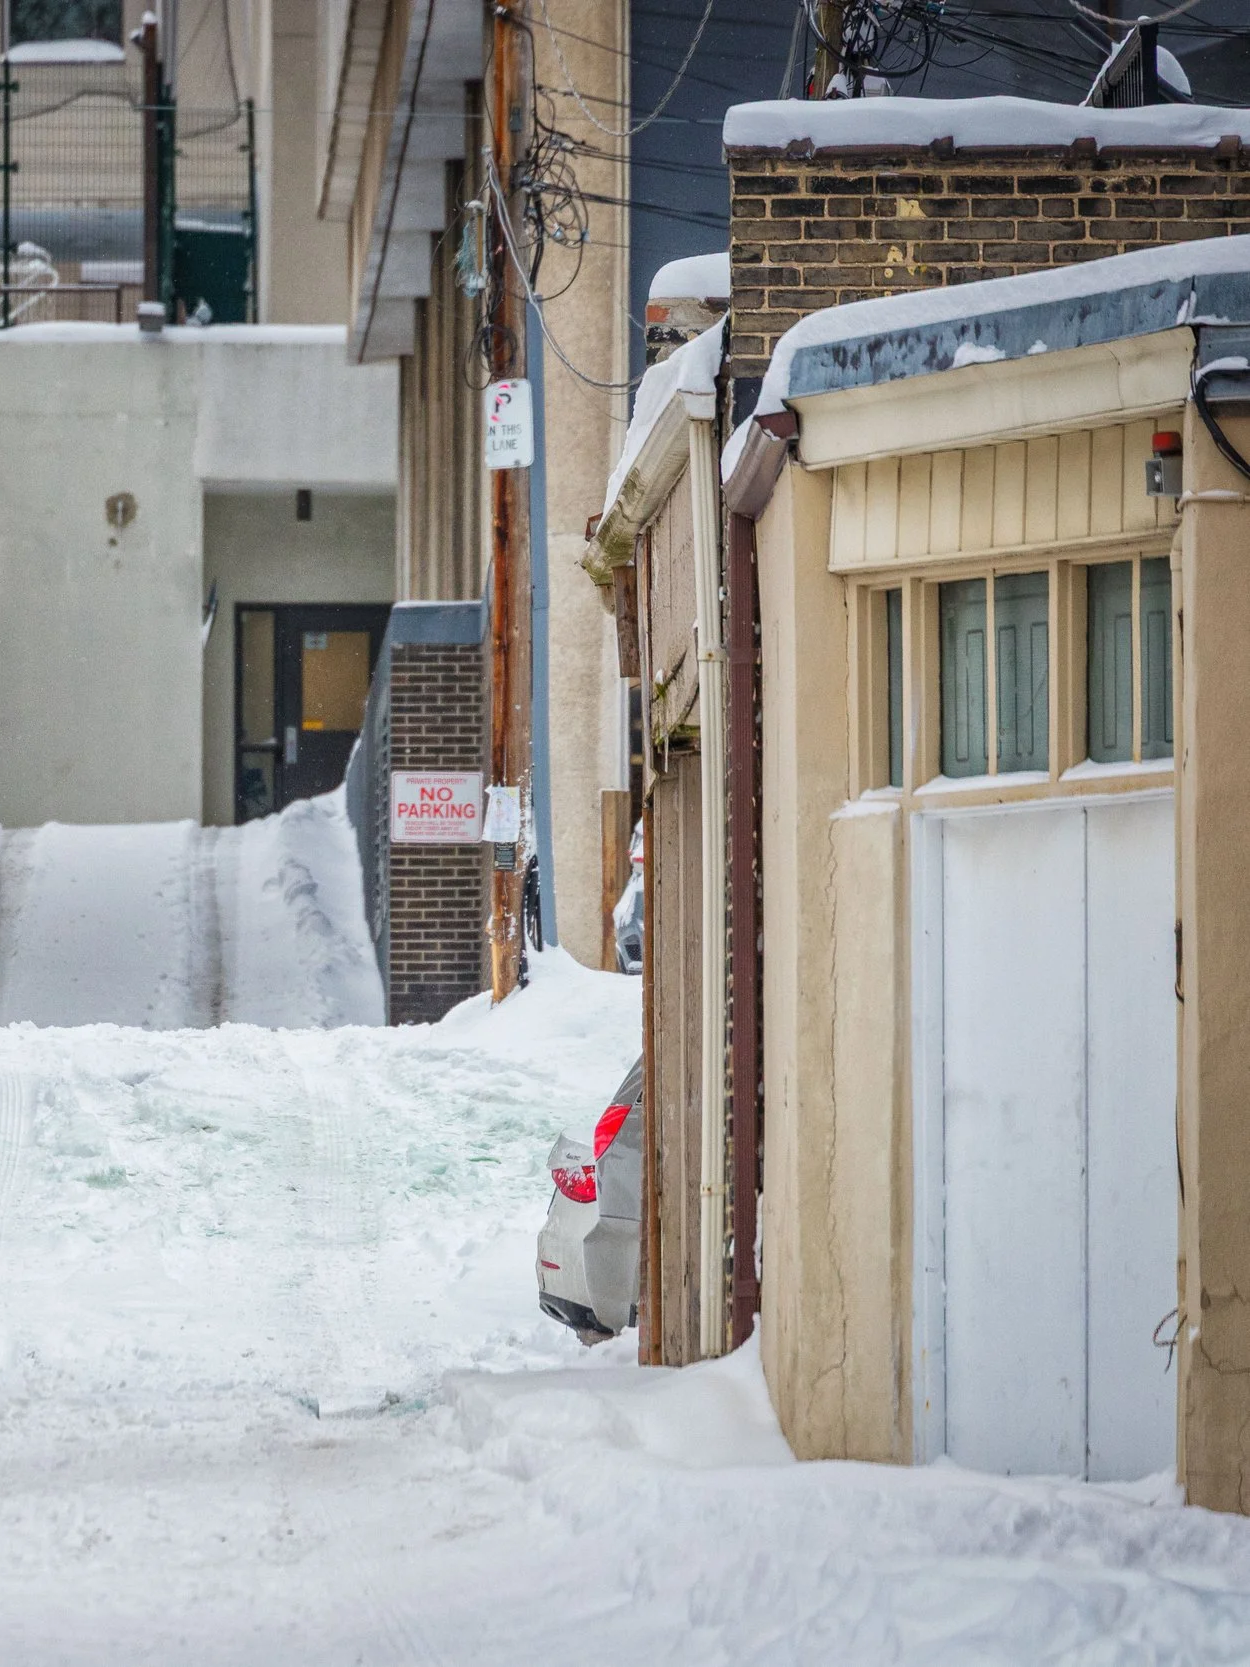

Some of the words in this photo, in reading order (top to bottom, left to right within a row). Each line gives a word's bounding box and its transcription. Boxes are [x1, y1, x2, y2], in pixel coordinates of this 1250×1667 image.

[501, 424, 522, 436] THIS
[492, 439, 518, 451] LANE
[420, 787, 453, 802] NO
[397, 803, 476, 819] PARKING
